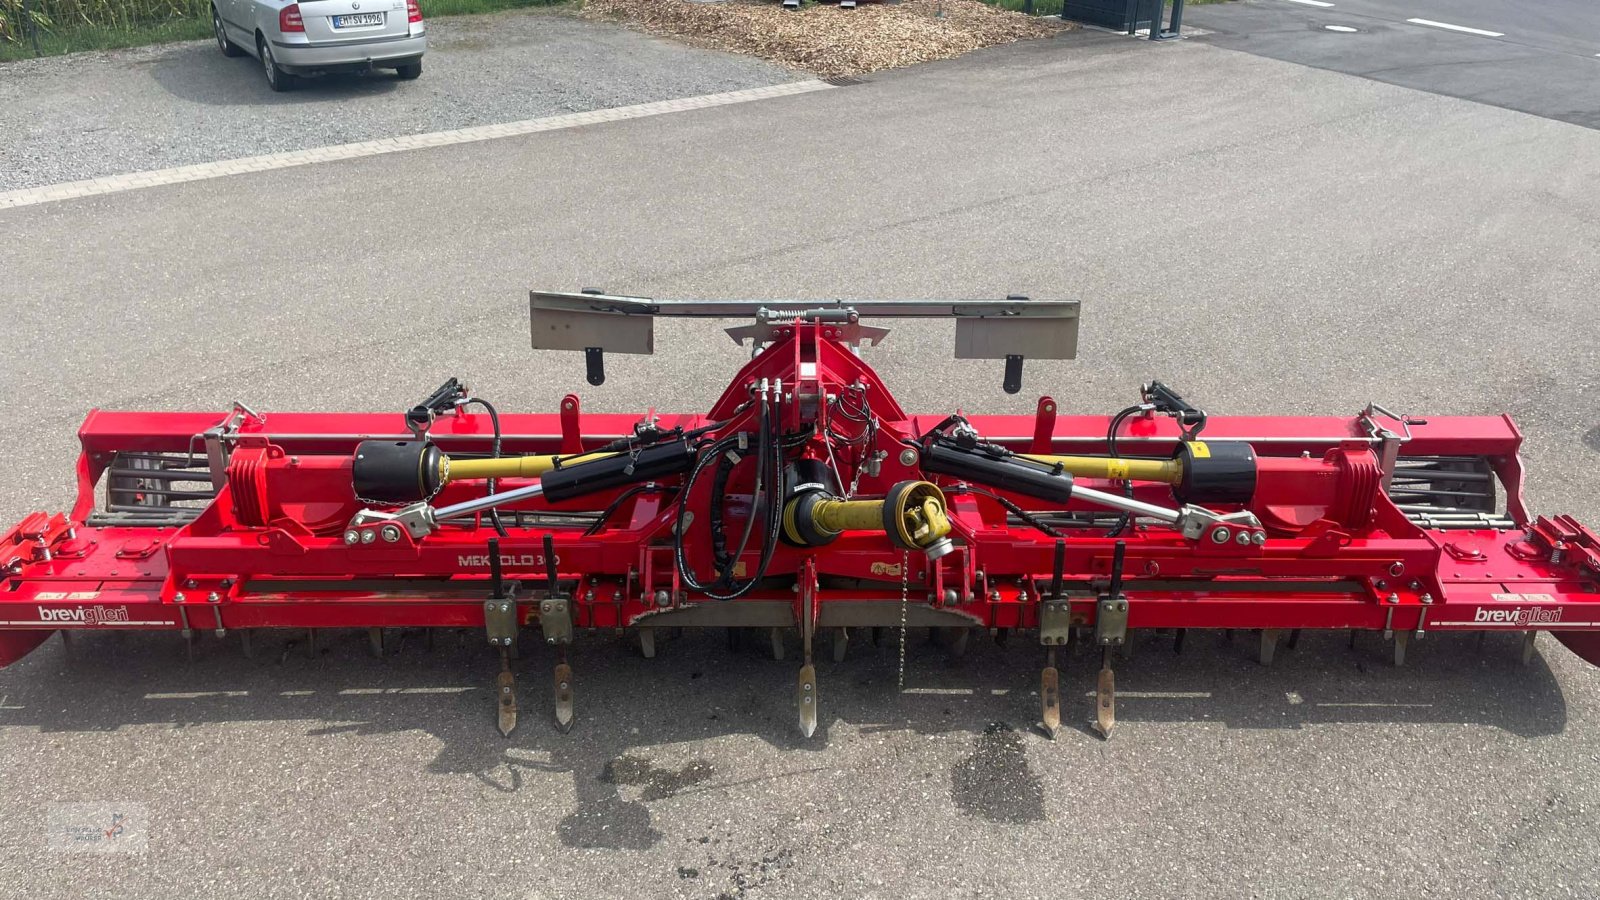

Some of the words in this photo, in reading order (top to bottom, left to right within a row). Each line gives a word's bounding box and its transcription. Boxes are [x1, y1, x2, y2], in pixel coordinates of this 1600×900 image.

[339, 15, 349, 25] EM
[353, 15, 362, 24] SV
[364, 14, 381, 23] 1996
[38, 606, 129, 625] breviglieri
[1474, 606, 1562, 626] breviglieri
